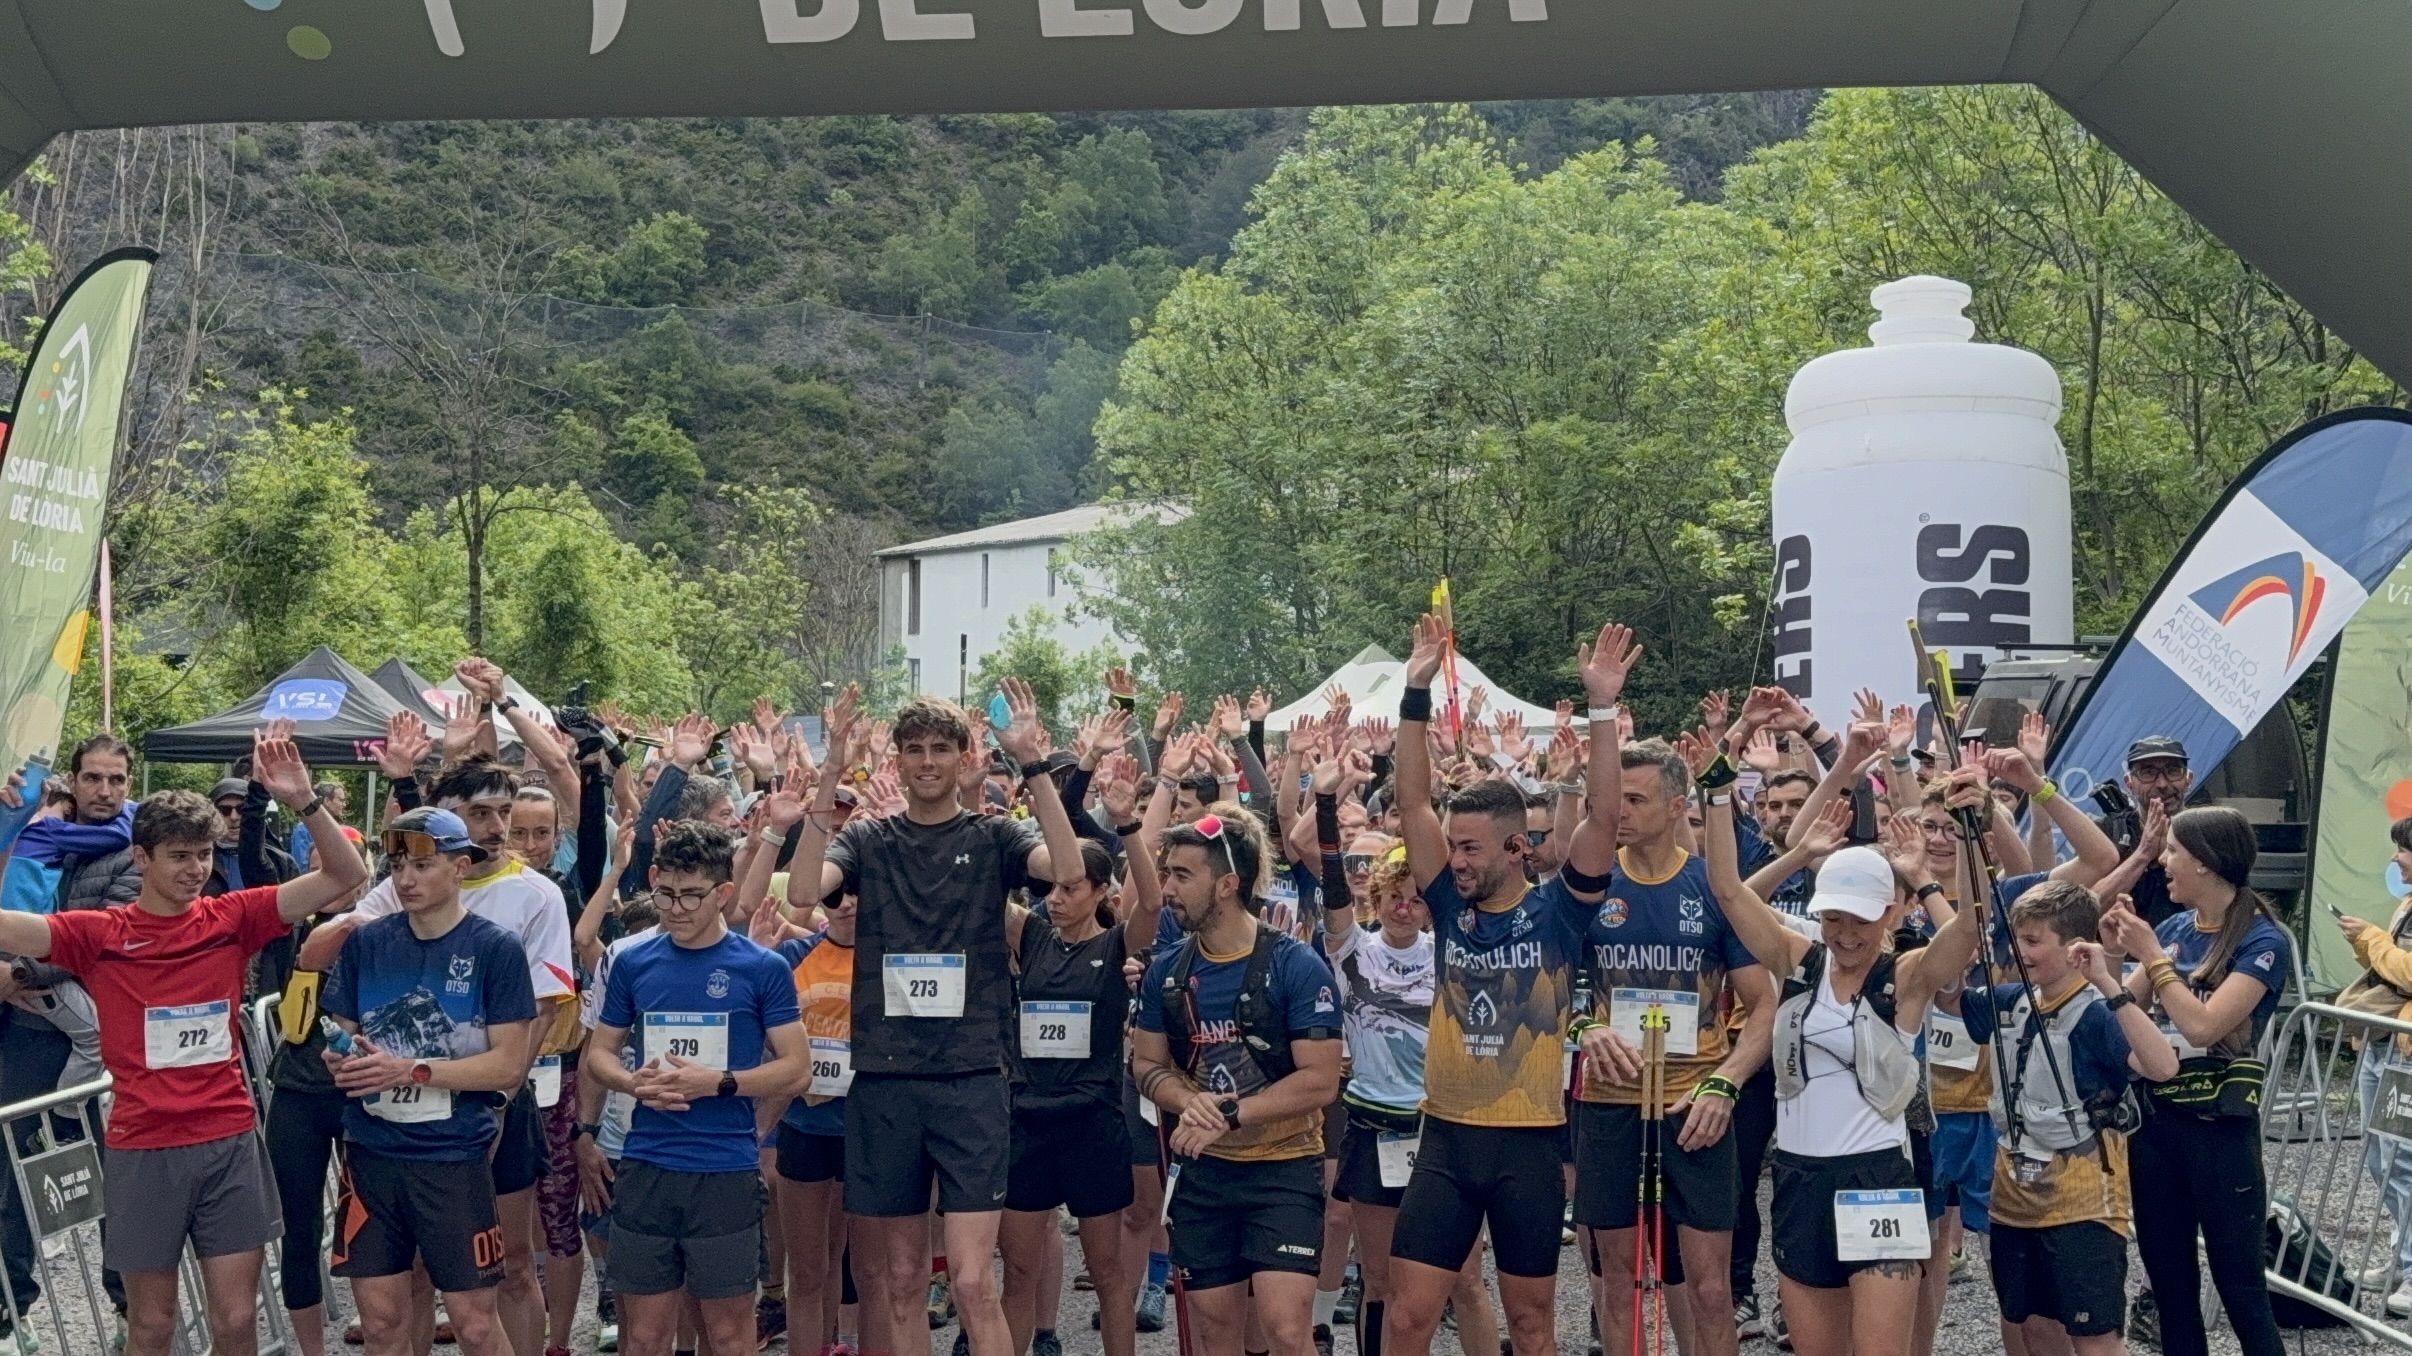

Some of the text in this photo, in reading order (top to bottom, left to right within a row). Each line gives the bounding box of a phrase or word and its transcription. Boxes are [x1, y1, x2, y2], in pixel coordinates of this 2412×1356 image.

[8, 456, 100, 500] SANT JULIÀ
[9, 494, 84, 534] DE LÒRIA
[11, 540, 67, 573] Viu-la
[2175, 604, 2259, 677] FEDERACIÓ
[2164, 618, 2261, 704] ANDORRANA
[2152, 628, 2257, 723] MUNTANYISME
[1512, 918, 1534, 938] OTSO
[1679, 919, 1703, 934] OTSO
[1594, 944, 1705, 972] ROCANOLICH
[445, 980, 470, 994] OTSO
[910, 979, 938, 998] 273
[1039, 1024, 1066, 1041] 228
[1640, 1014, 1671, 1034] 35
[178, 1028, 208, 1049] 272
[669, 1038, 699, 1057] 379
[1480, 1033, 1504, 1046] JULIÀ
[1465, 1044, 1499, 1057] DE LÒRIA
[812, 1060, 841, 1079] 260
[1869, 1218, 1901, 1238] 281
[473, 1223, 505, 1268] OTS
[1288, 1245, 1316, 1257] TERREX
